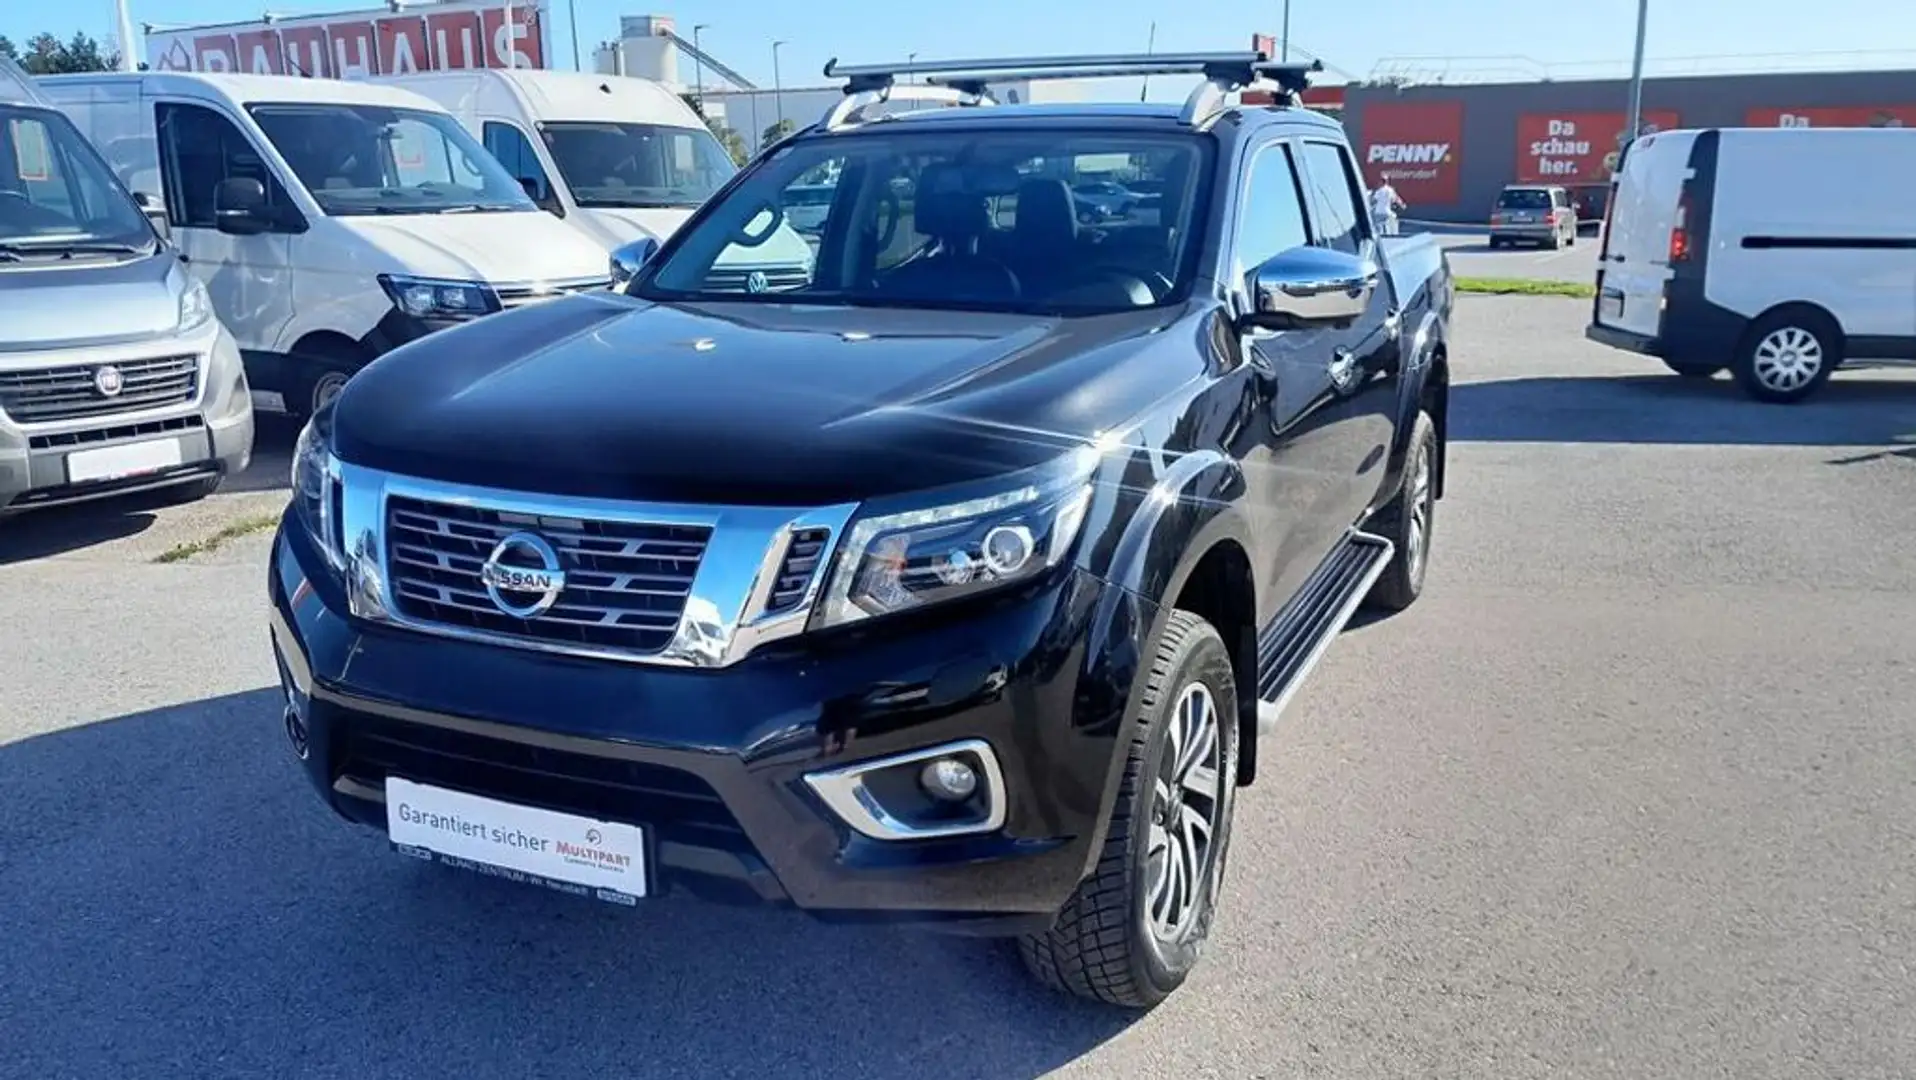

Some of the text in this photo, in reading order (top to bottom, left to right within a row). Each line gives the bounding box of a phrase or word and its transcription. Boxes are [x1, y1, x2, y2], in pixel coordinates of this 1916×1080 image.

[1549, 119, 1575, 136] Da
[1531, 138, 1590, 155] schau
[1539, 157, 1578, 174] her.
[399, 802, 549, 853] Garantiert sicher
